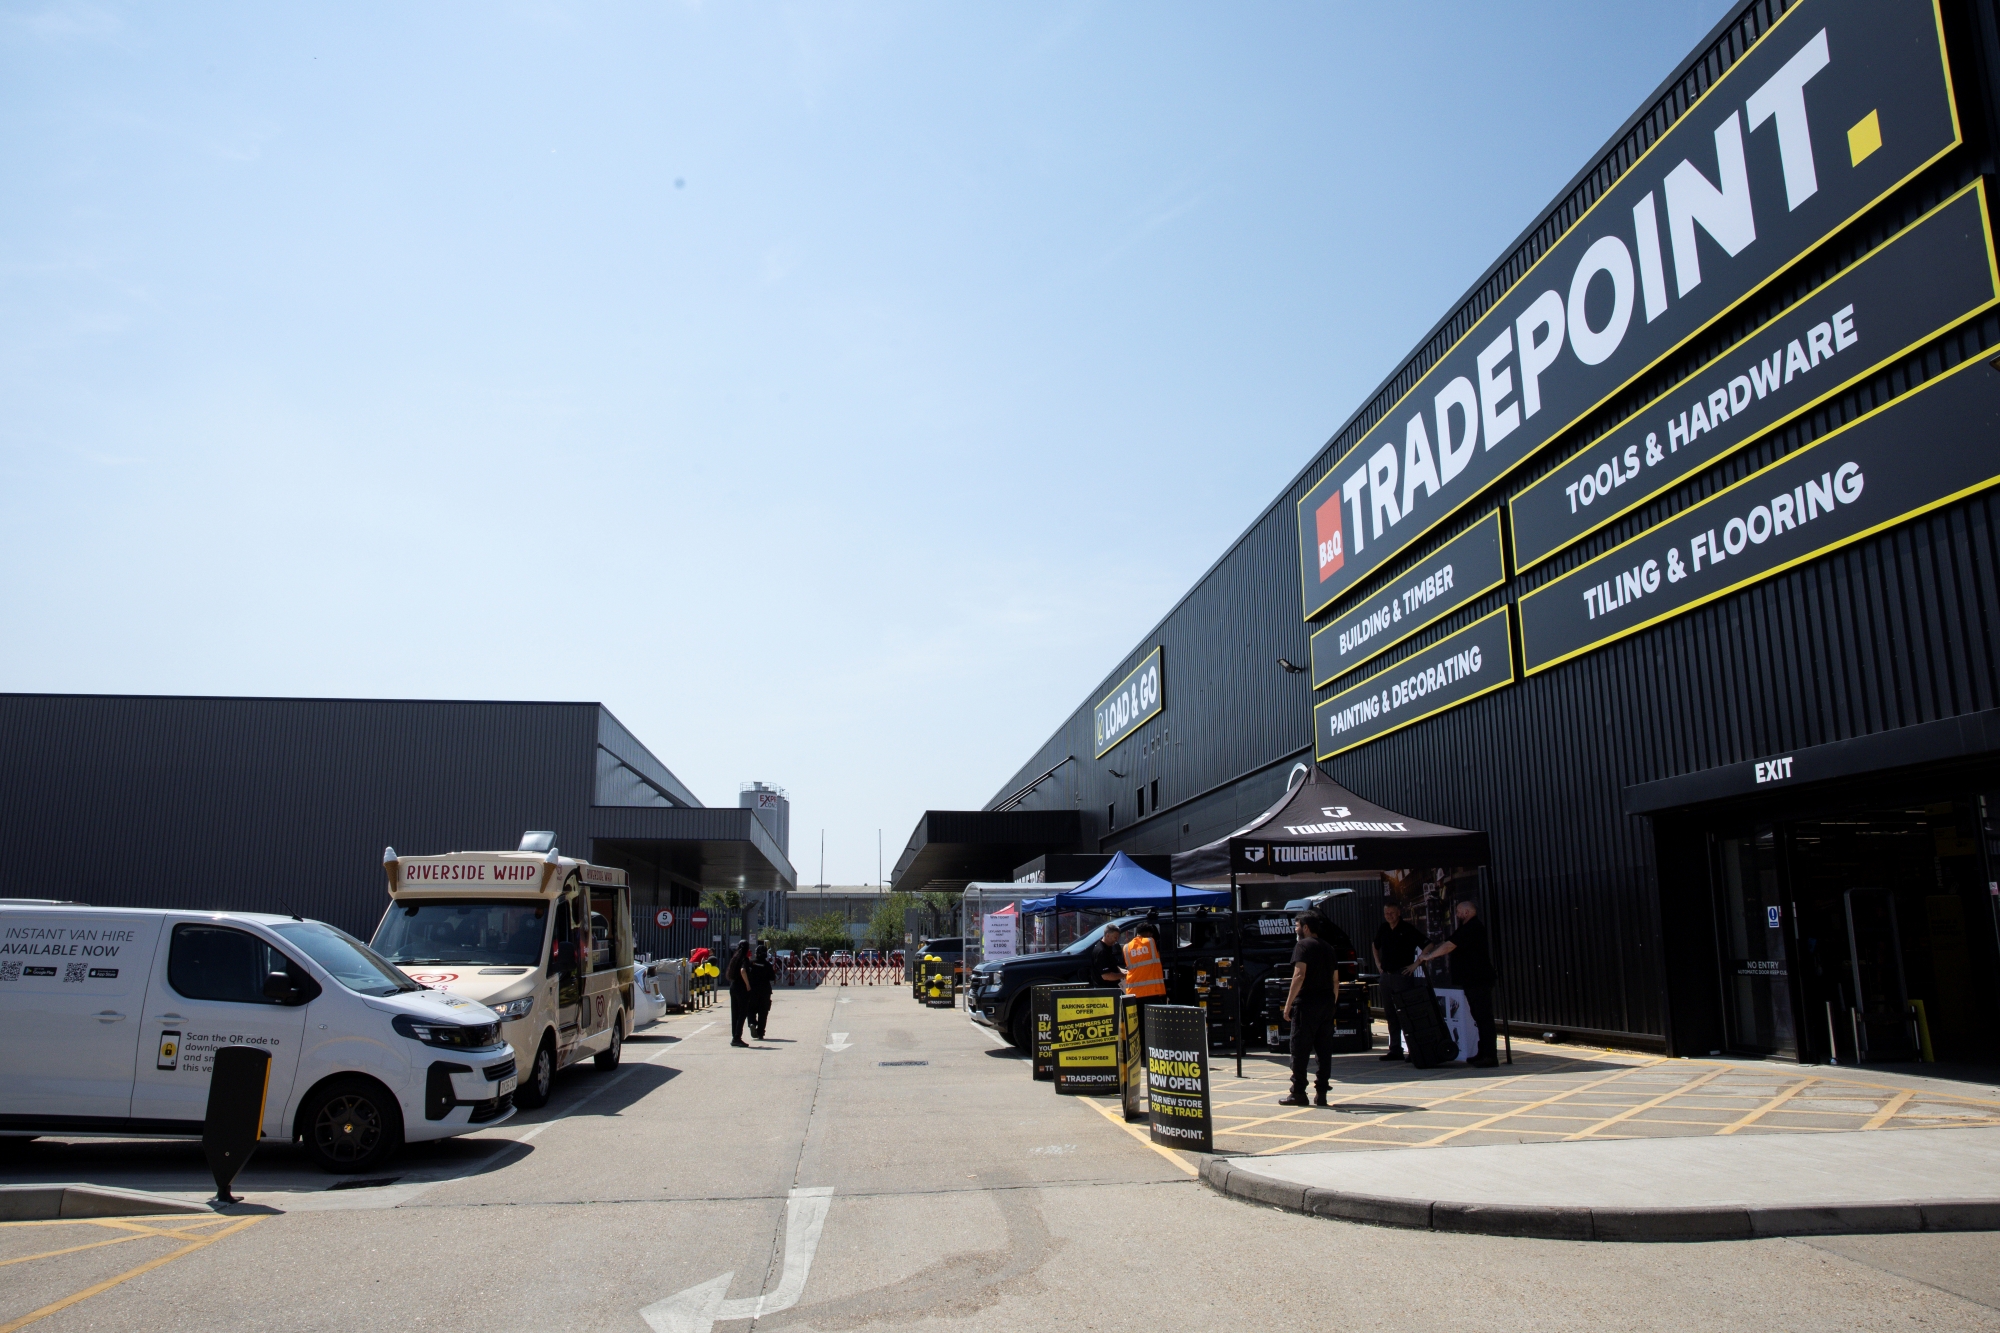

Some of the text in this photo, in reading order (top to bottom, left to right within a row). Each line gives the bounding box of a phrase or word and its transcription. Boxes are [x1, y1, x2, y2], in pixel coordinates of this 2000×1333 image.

[1565, 303, 1858, 514] TOOLS & HARDWARE
[1583, 461, 1865, 620] TILING & FLOORING
[1318, 530, 1342, 569] B&Q
[1339, 564, 1454, 656] BUILDING & TIMBER
[1330, 645, 1482, 737] PAINTING & DECORATING
[1105, 665, 1157, 740] LOAD & GO
[1754, 756, 1793, 784] EXIT
[1284, 821, 1409, 835] TOUGHBUILT
[1272, 845, 1356, 863] TOUGHBUILT
[406, 864, 536, 881] RIVERSIDE WHIP
[662, 912, 668, 920] 5
[1258, 918, 1289, 927] DRIVEN
[5, 927, 135, 942] INSTANT VAN HIRE
[1260, 926, 1296, 935] INNOVAT
[0, 943, 120, 957] AVAILABLE NOW
[1130, 945, 1149, 957] B&Q
[1747, 960, 1779, 969] NO ENTRY
[1074, 1020, 1101, 1029] MEMBERS
[186, 1032, 280, 1046] Scan the QR code to
[1058, 1024, 1114, 1042] 10% OFF
[185, 1043, 219, 1052] downlo
[1148, 1046, 1200, 1062] TRADEPOINT
[183, 1054, 202, 1062] and
[182, 1063, 199, 1072] this
[1148, 1058, 1201, 1078] BARKING
[1149, 1073, 1202, 1091] NOW OPEN
[1150, 1093, 1162, 1104] YOUR
[1162, 1095, 1177, 1106] NEW
[1177, 1098, 1203, 1109] STORE
[1151, 1101, 1203, 1118] FOR THE TRADE
